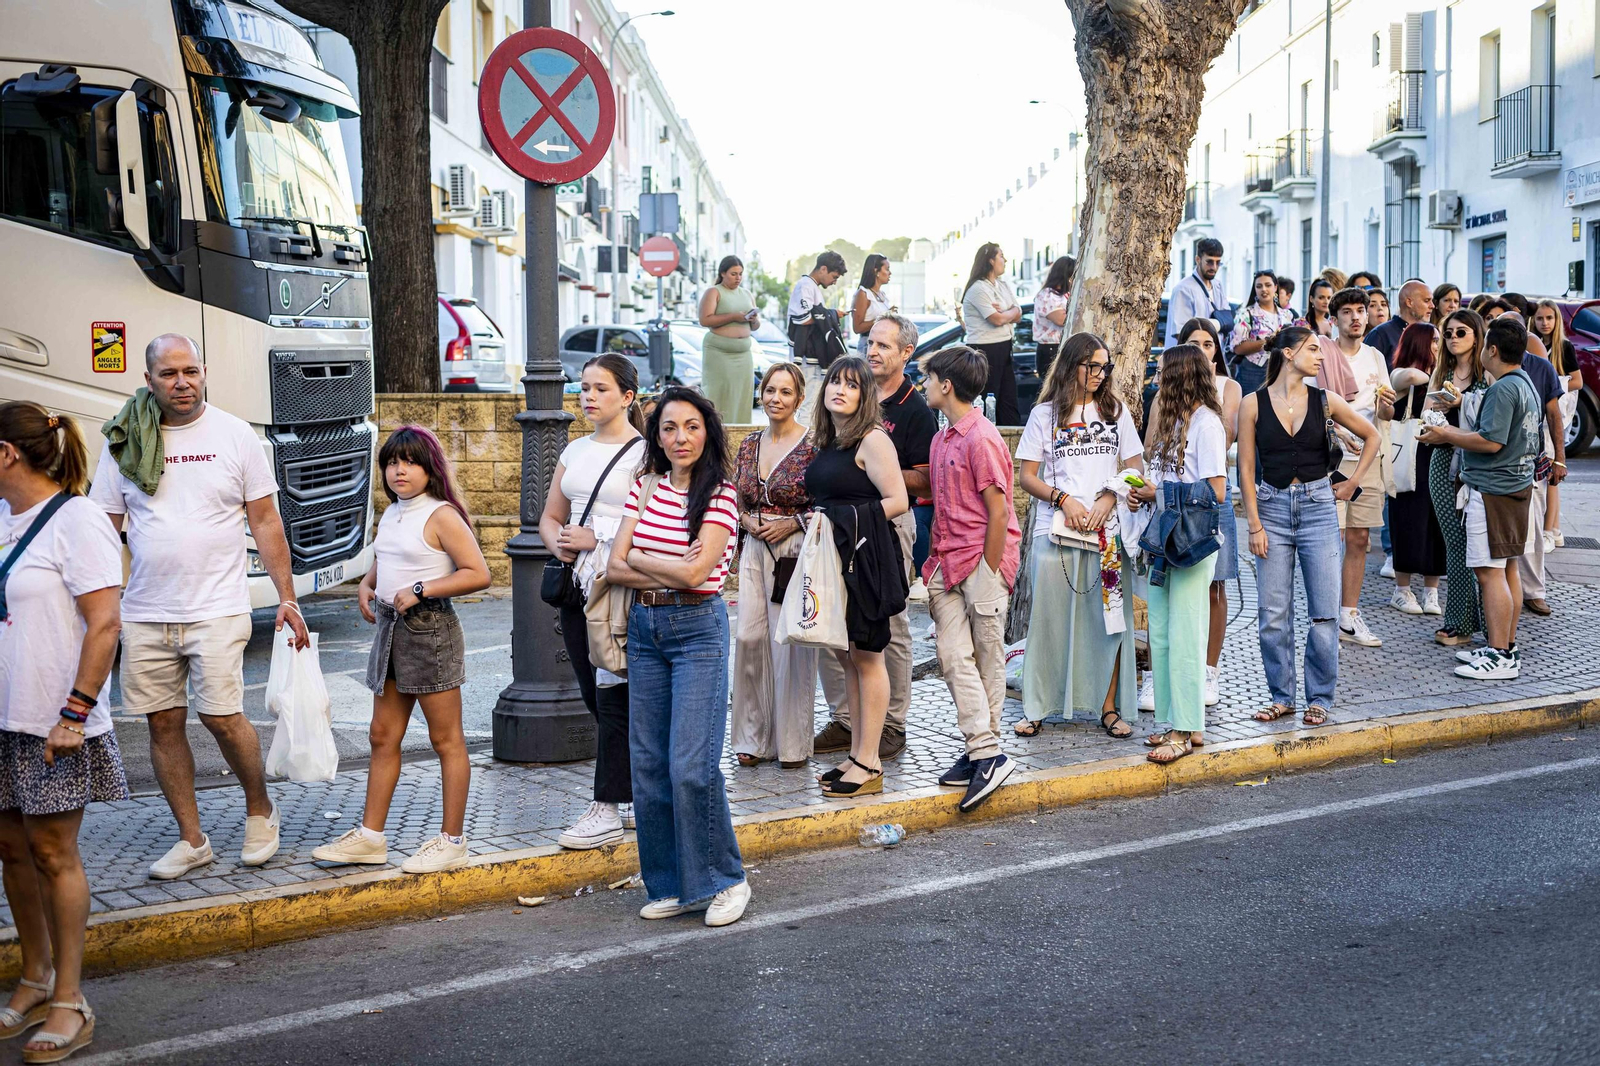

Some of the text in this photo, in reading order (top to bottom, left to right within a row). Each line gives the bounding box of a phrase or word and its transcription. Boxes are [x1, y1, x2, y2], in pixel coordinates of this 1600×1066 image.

[237, 12, 263, 44] EL
[1054, 445, 1118, 460] EN CONCIERTO
[318, 568, 333, 588] 6764
